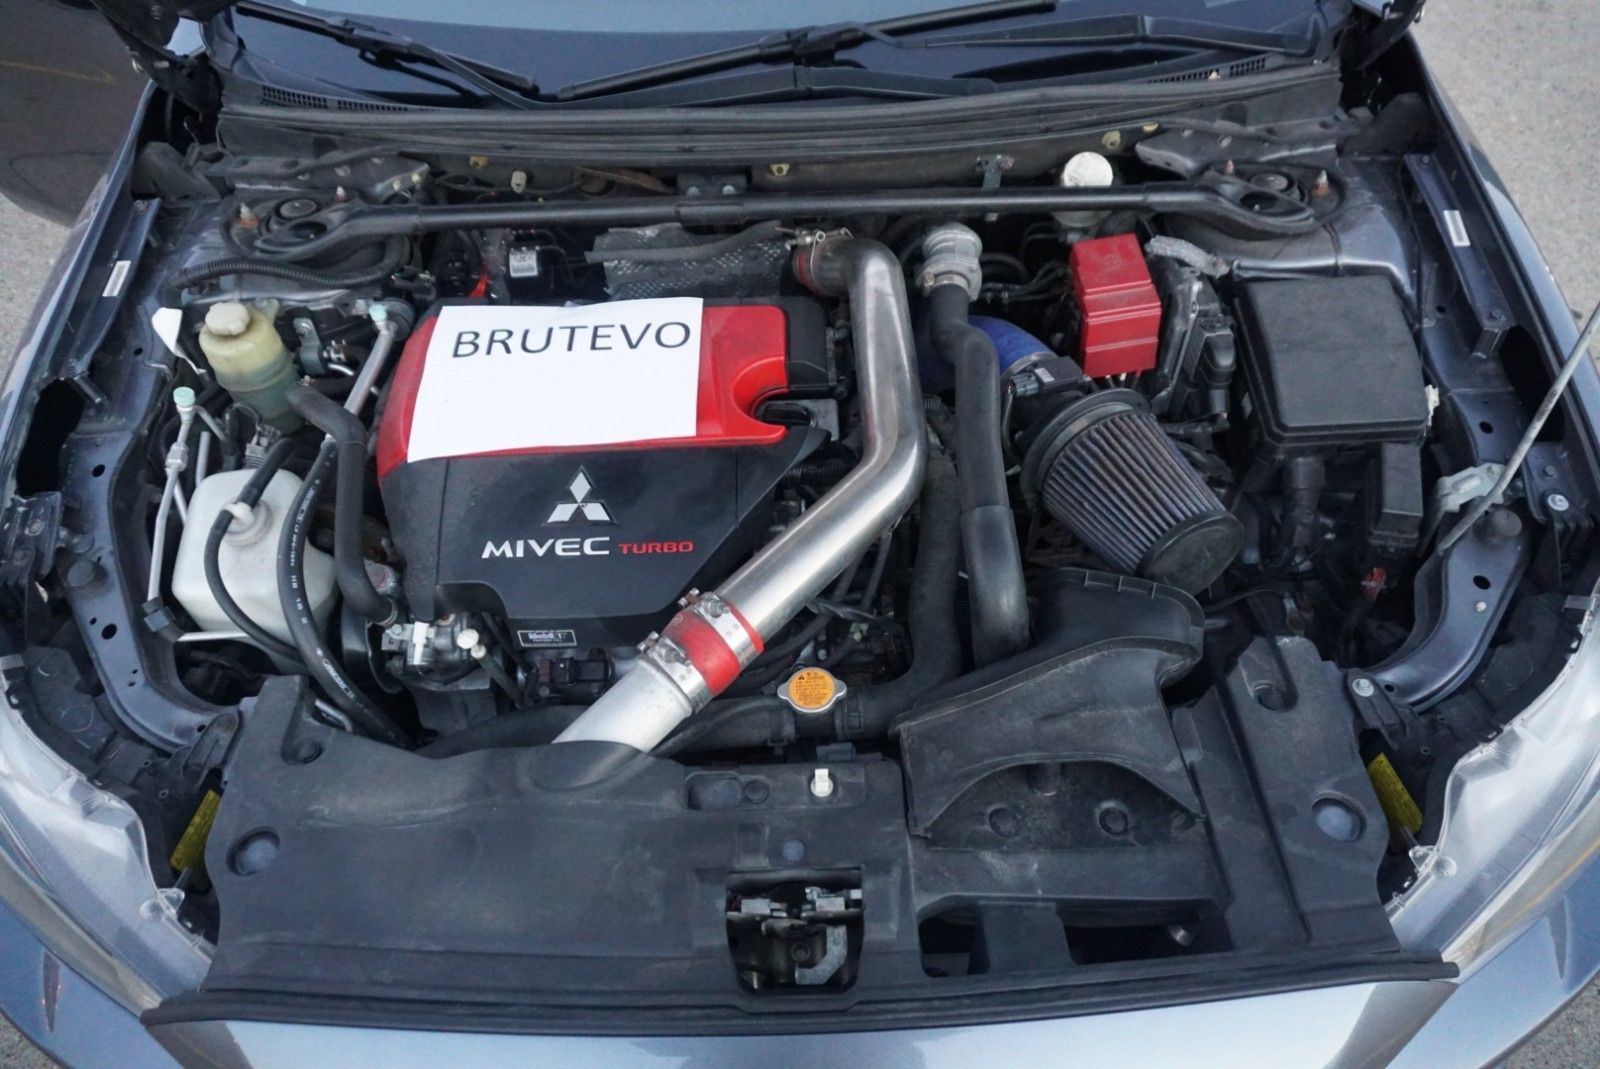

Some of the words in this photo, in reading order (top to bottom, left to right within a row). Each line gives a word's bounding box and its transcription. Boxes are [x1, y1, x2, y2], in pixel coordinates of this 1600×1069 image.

[452, 321, 691, 358] BRUTEVO
[481, 536, 610, 559] MIVEC
[618, 539, 694, 555] TURBO
